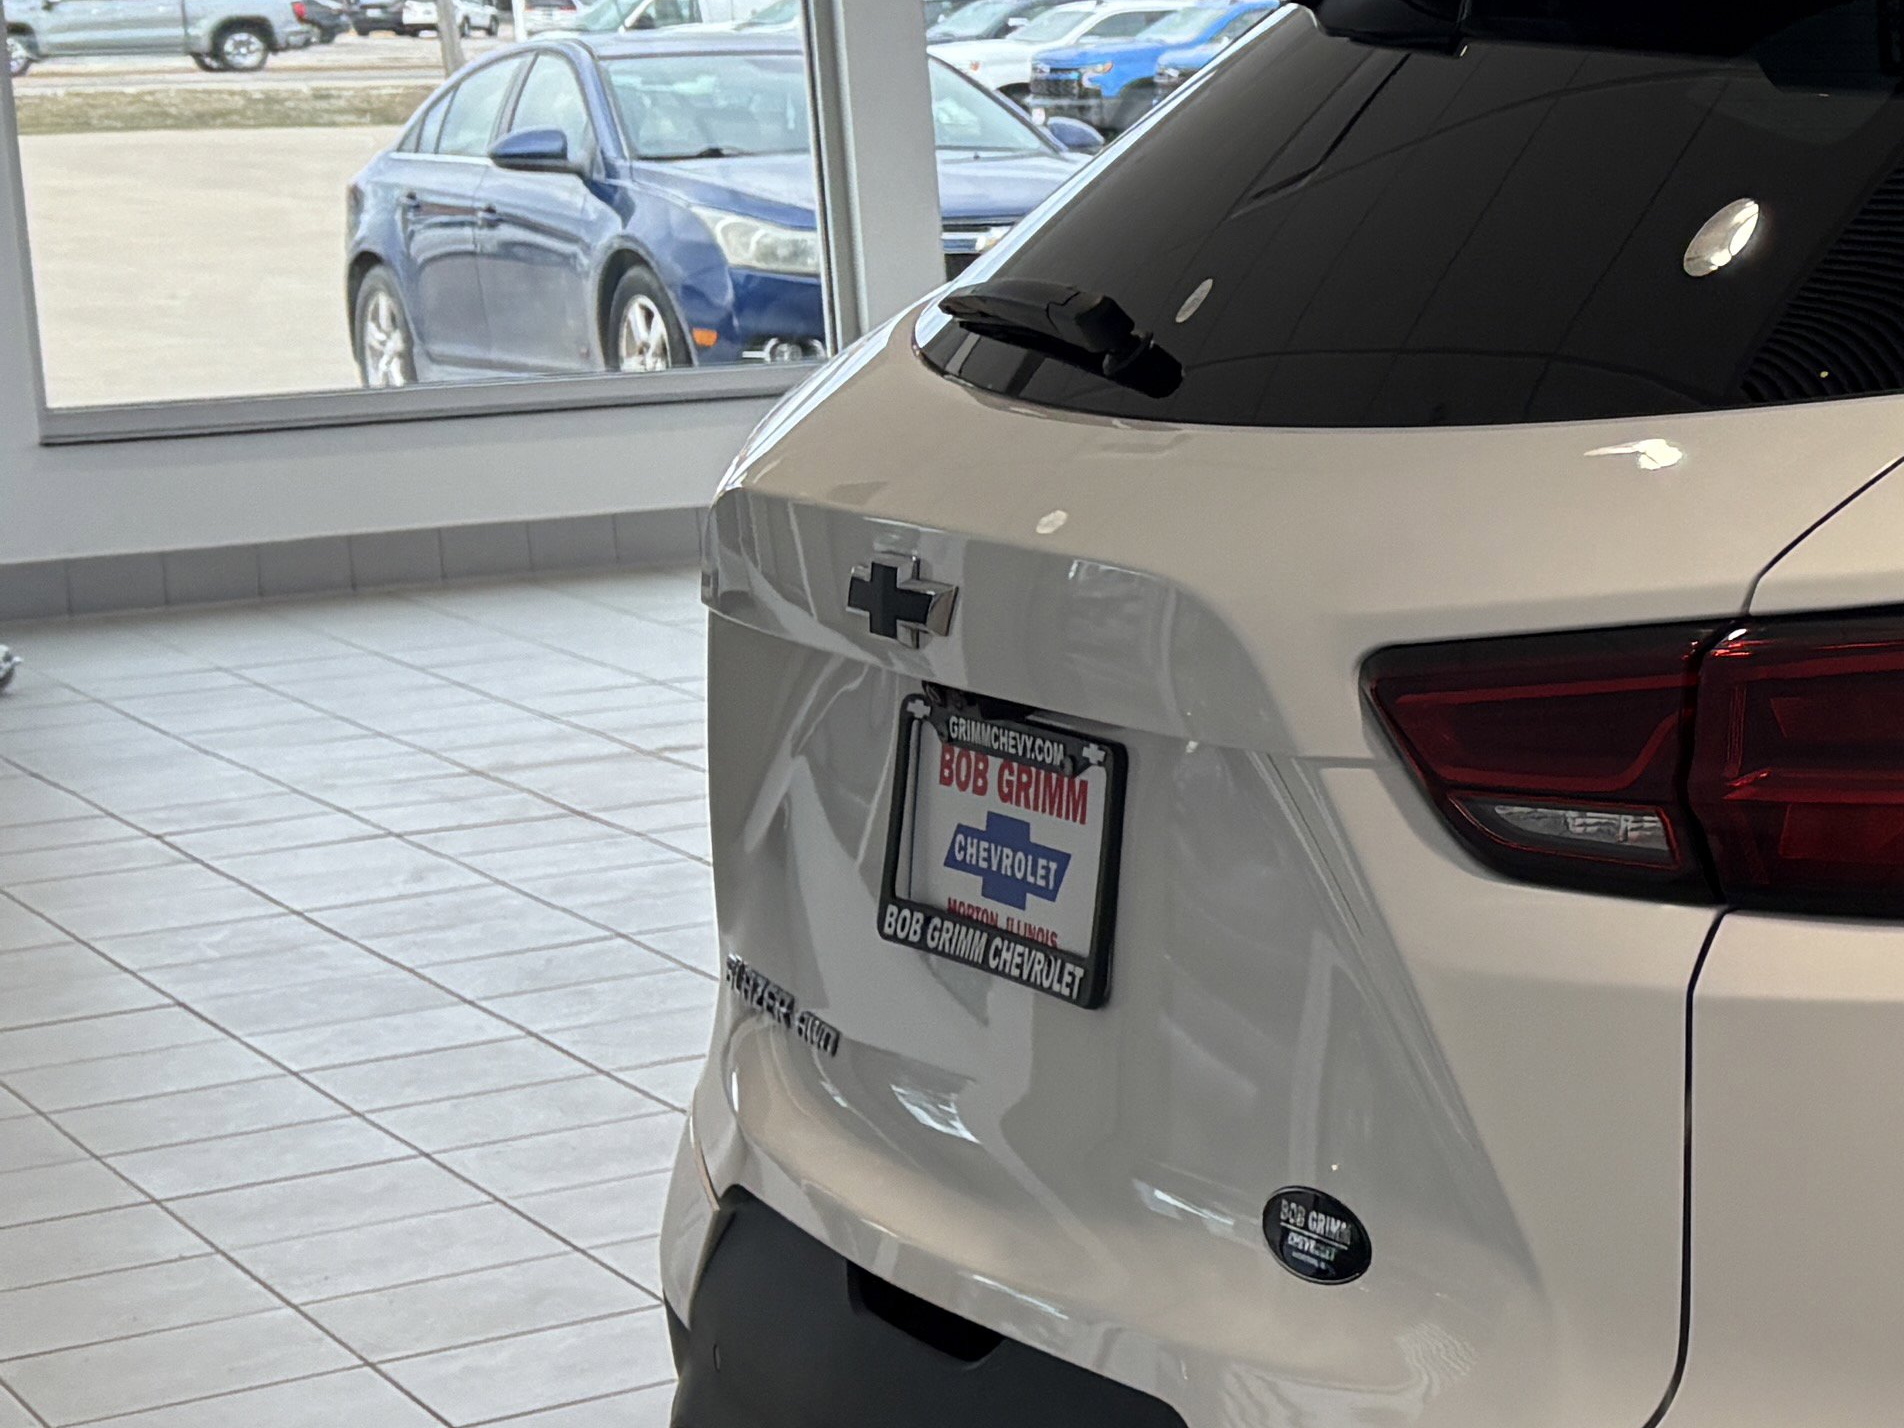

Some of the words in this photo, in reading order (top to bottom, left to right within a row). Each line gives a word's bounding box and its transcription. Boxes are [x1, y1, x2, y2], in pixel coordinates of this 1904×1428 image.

[949, 715, 1064, 765] GRIMMCHEVY.COM
[939, 744, 989, 797] BOB
[997, 759, 1088, 825] GRIMM
[954, 833, 1058, 890] CHEVROLET
[883, 904, 924, 943] BOB
[926, 916, 988, 964] GRIMM
[989, 936, 1085, 1000] CHEVROLET
[1280, 1199, 1306, 1227] BOB
[1308, 1210, 1351, 1245] GRIMM
